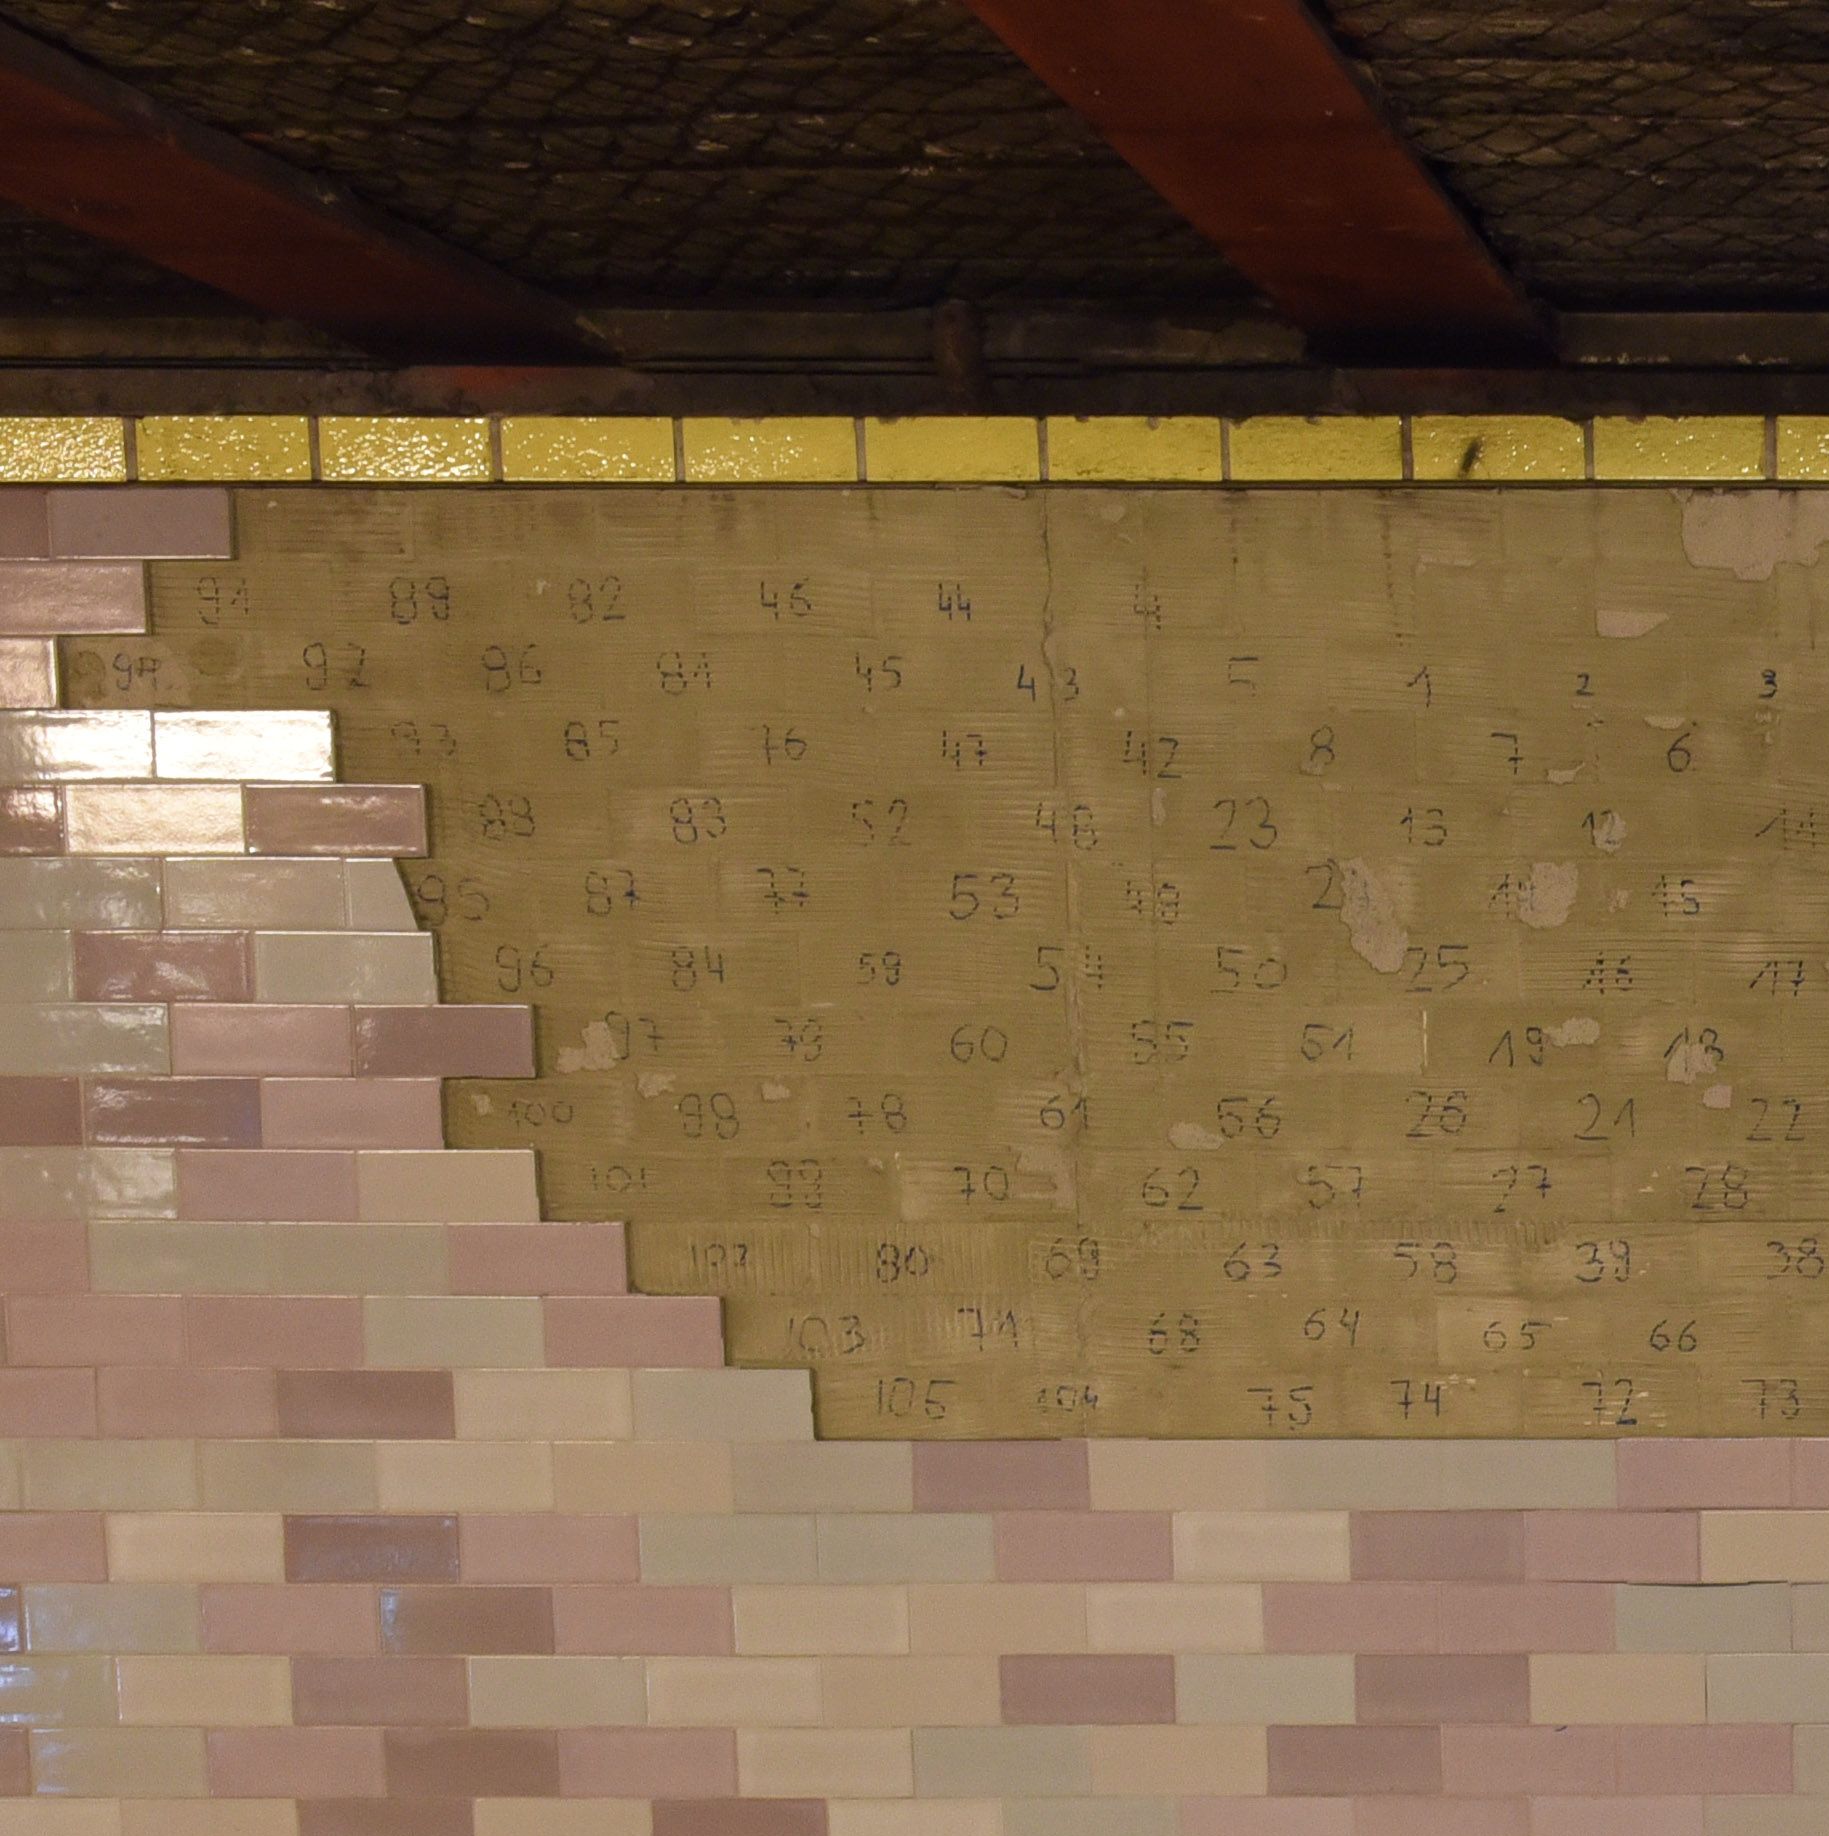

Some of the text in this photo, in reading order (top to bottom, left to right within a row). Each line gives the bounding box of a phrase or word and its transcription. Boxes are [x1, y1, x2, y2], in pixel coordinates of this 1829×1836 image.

[568, 575, 626, 624] 82
[760, 577, 812, 621] 46
[938, 583, 971, 621] 44
[1134, 584, 1161, 630] 4
[481, 643, 542, 693] 86
[656, 651, 711, 696] 81
[855, 651, 902, 692] 45
[1016, 664, 1079, 701] 43
[1228, 656, 1259, 697] 5
[1407, 665, 1432, 708] 1
[1576, 673, 1594, 697] 2
[1759, 668, 1778, 699] 3
[564, 720, 619, 761] 85
[1123, 730, 1182, 779] 42
[1310, 725, 1335, 767] 8
[1490, 732, 1524, 776] 7
[669, 797, 727, 845] 83
[851, 798, 911, 848] 52
[1035, 802, 1098, 850] 48
[1210, 796, 1279, 850] 23
[1400, 807, 1448, 847] 13
[585, 869, 638, 917] 87
[756, 867, 810, 915] 77
[948, 872, 1020, 921] 53
[1651, 874, 1701, 917] 15
[496, 943, 554, 993] 96
[672, 945, 725, 992] 84
[1029, 945, 1104, 991] 54
[1211, 946, 1287, 993] 50
[1405, 945, 1470, 993] 25
[1749, 960, 1805, 998] 17
[605, 1010, 664, 1060] 97
[774, 1018, 822, 1062] 79
[950, 1023, 1008, 1063] 60
[1131, 1019, 1195, 1065] 55
[1489, 1027, 1545, 1068] 19
[679, 1092, 740, 1139] 98
[848, 1093, 907, 1135] 78
[1039, 1094, 1088, 1131] 61
[1217, 1097, 1281, 1139] 56
[1405, 1090, 1468, 1138] 26
[1574, 1092, 1636, 1141] 21
[1746, 1097, 1806, 1142] 22
[953, 1165, 1009, 1205] 70
[1141, 1166, 1203, 1210] 62
[1307, 1165, 1362, 1209] 57
[1685, 1163, 1749, 1210] 28
[876, 1243, 930, 1283] 80
[1223, 1242, 1282, 1281] 63
[1393, 1242, 1457, 1284] 58
[1575, 1239, 1630, 1283] 39
[1766, 1237, 1825, 1280] 38
[788, 1314, 866, 1356] 103
[958, 1307, 1019, 1351] 71
[1148, 1312, 1200, 1354] 68
[1304, 1308, 1361, 1347] 64
[1483, 1320, 1552, 1351] 65
[1649, 1319, 1698, 1353] 66
[877, 1377, 957, 1419] 105
[1247, 1385, 1314, 1429] 75
[1391, 1379, 1441, 1419] 74
[1582, 1378, 1638, 1426] 72
[1741, 1378, 1800, 1420] 73
